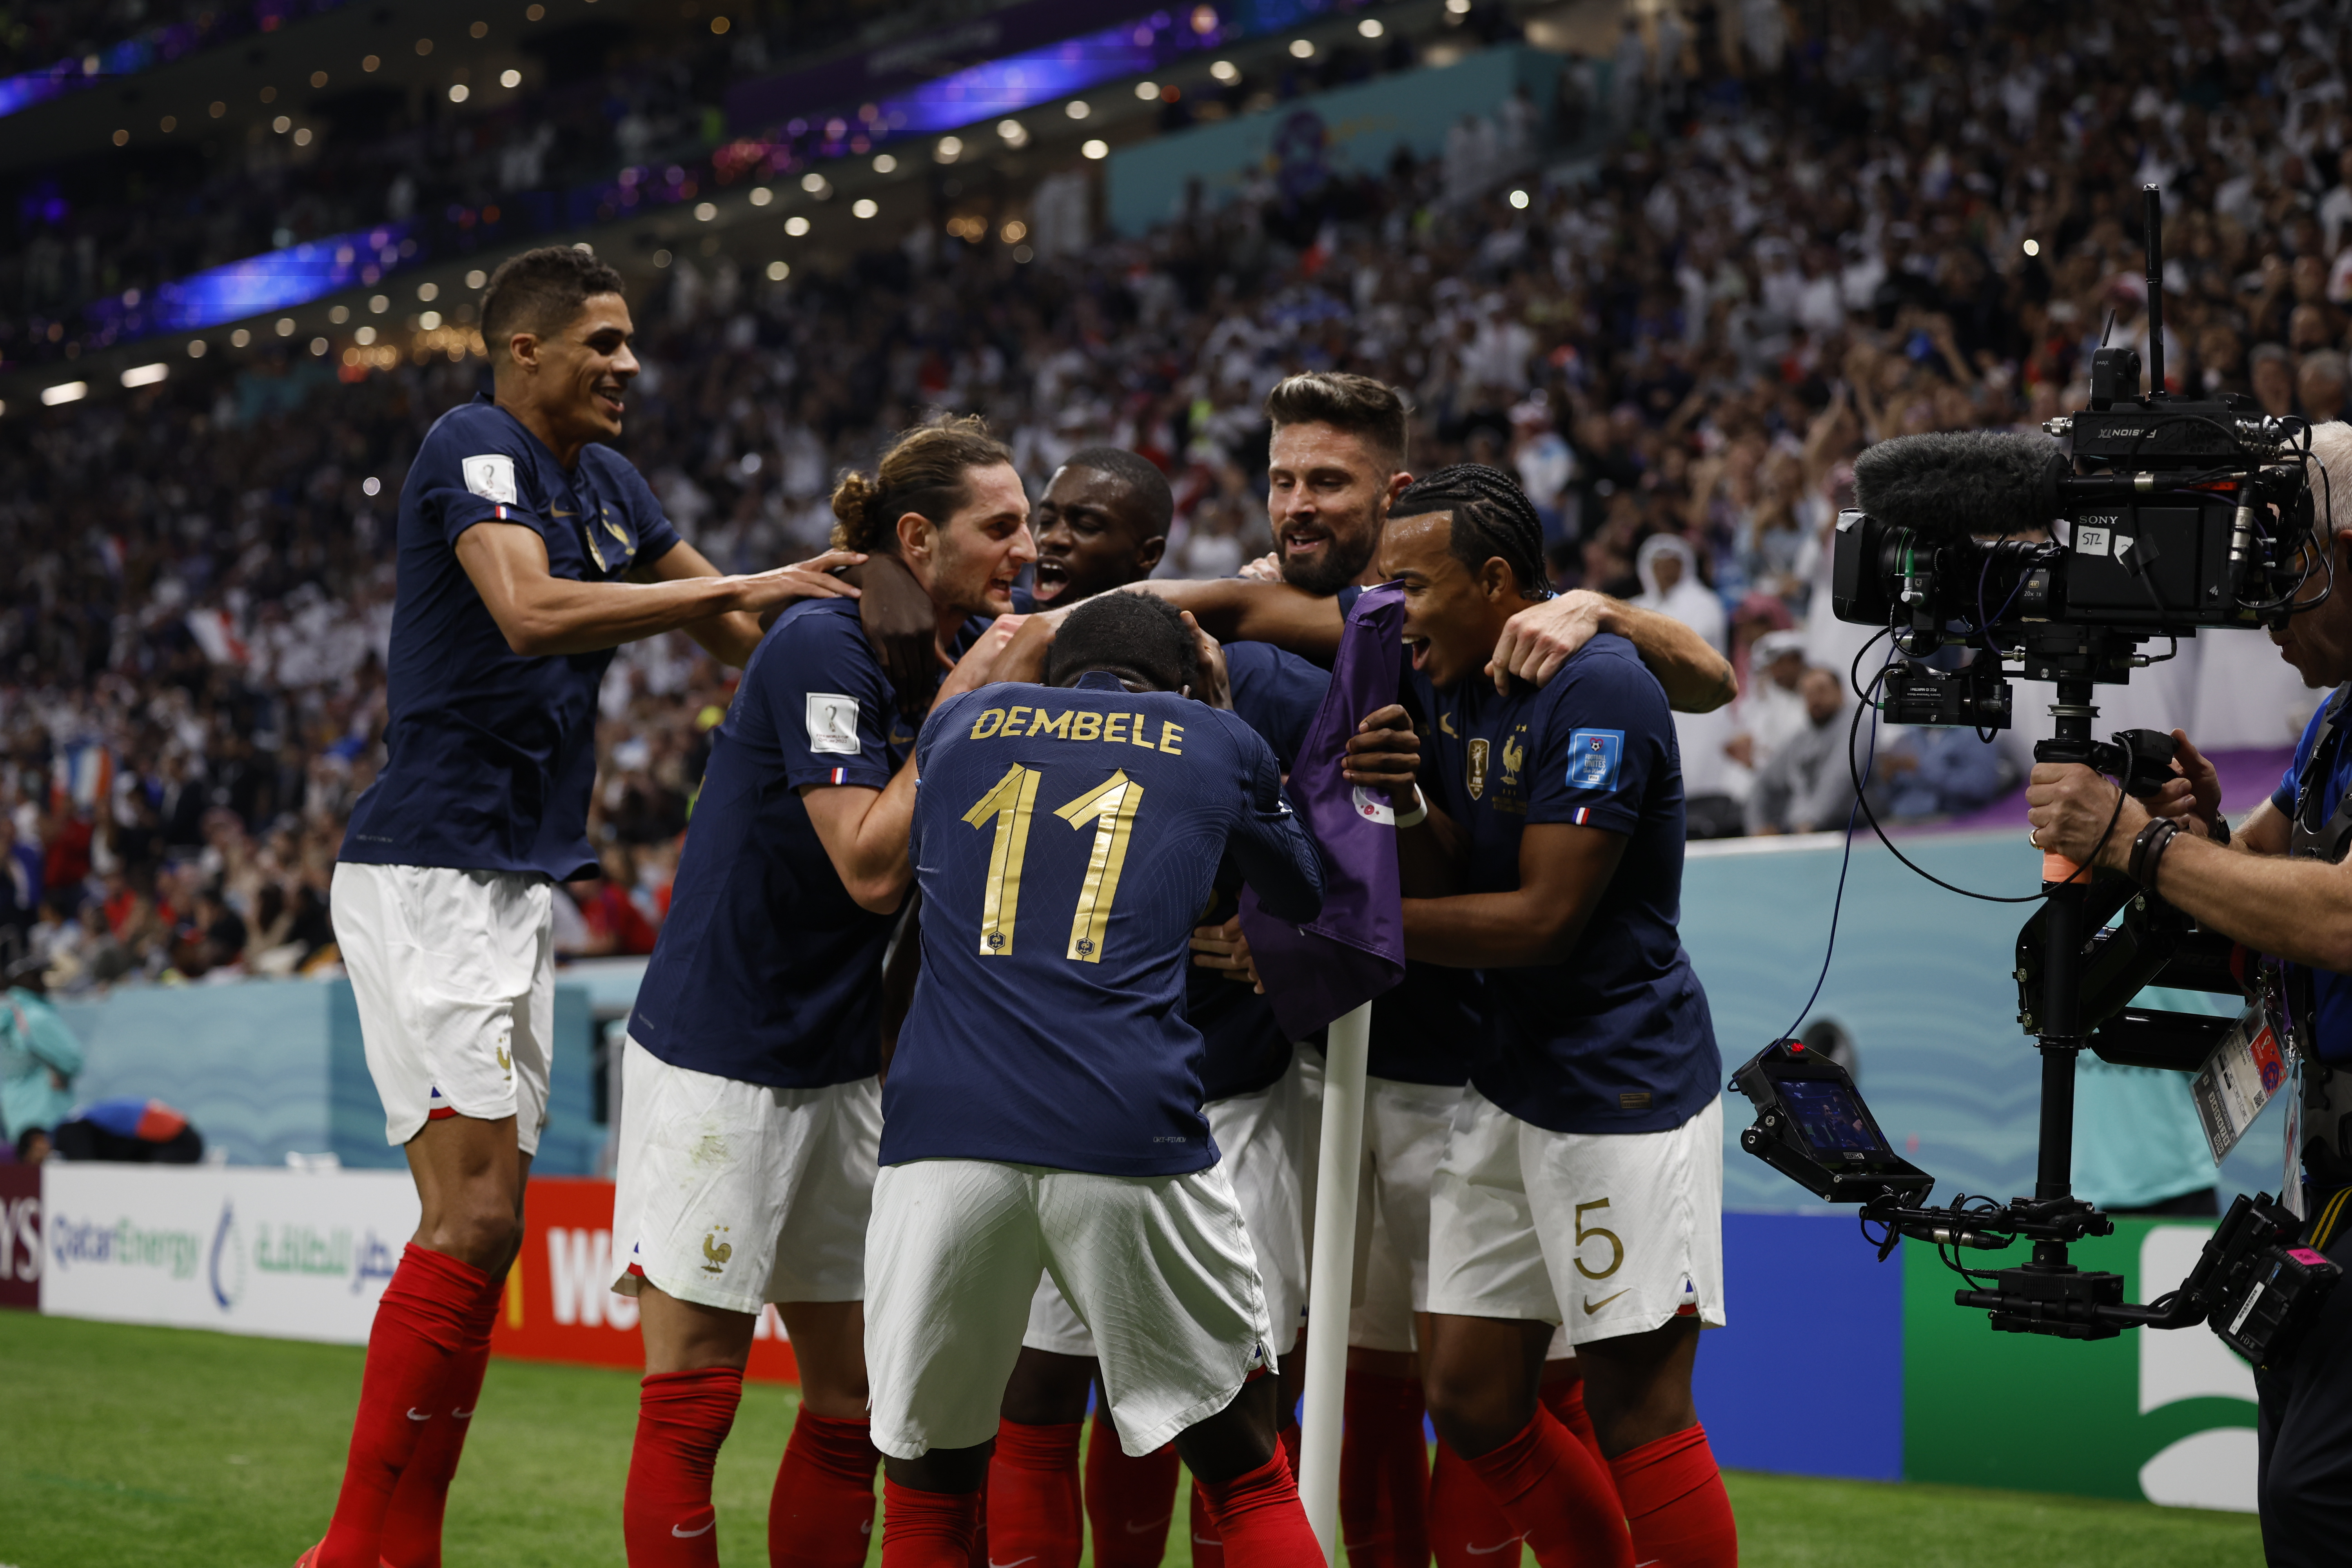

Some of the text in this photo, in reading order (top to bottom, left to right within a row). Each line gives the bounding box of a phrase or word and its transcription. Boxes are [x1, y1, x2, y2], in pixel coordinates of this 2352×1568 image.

[2079, 515, 2119, 524] SONY
[969, 705, 1185, 755] DEMBELE
[1584, 760, 1606, 768] UNITES
[960, 762, 1145, 964] 11
[2216, 1090, 2232, 1132] BROADCASTER
[2214, 1134, 2223, 1153] 15 16
[50, 1213, 201, 1279] QatarEnergy
[1573, 1197, 1624, 1280] 5
